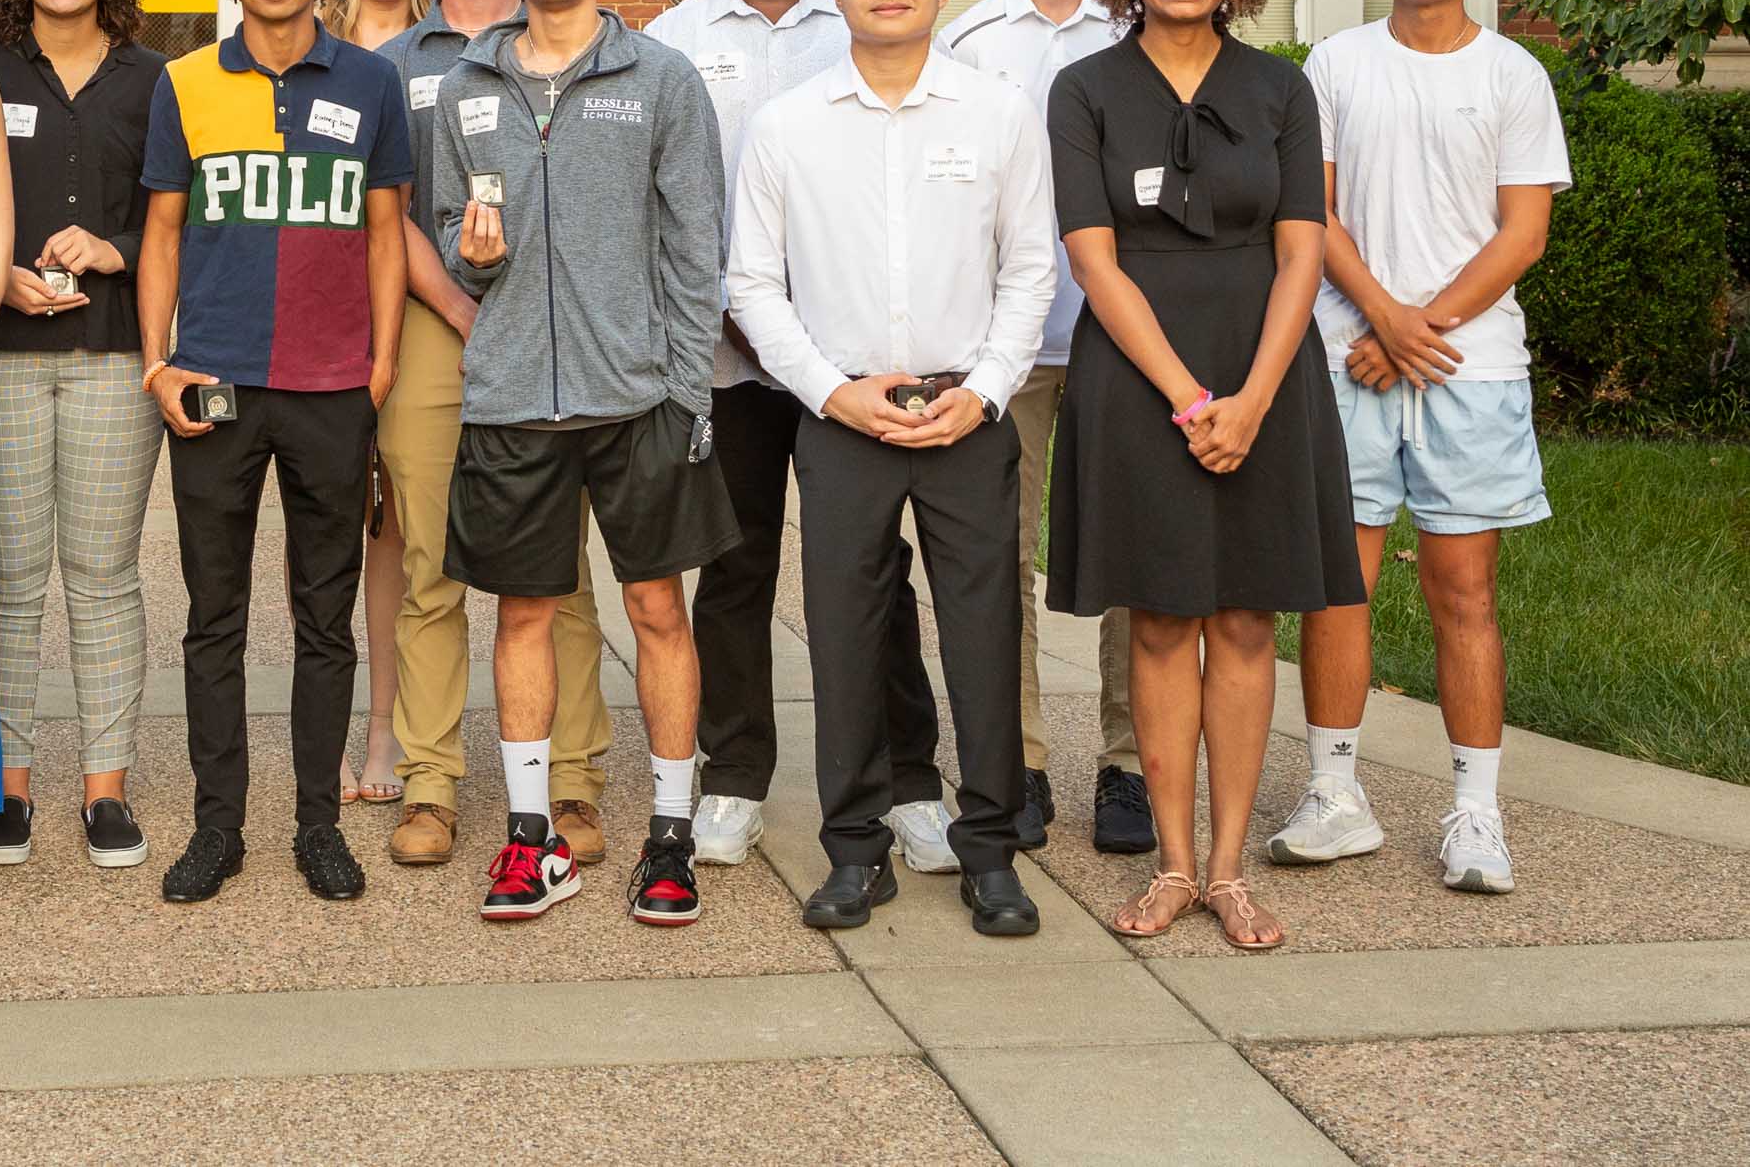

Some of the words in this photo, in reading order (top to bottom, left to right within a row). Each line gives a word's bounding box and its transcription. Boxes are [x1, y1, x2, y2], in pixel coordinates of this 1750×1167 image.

[583, 97, 643, 112] KESSLER
[582, 111, 642, 122] SCHOLARS
[201, 153, 364, 226] POLO
